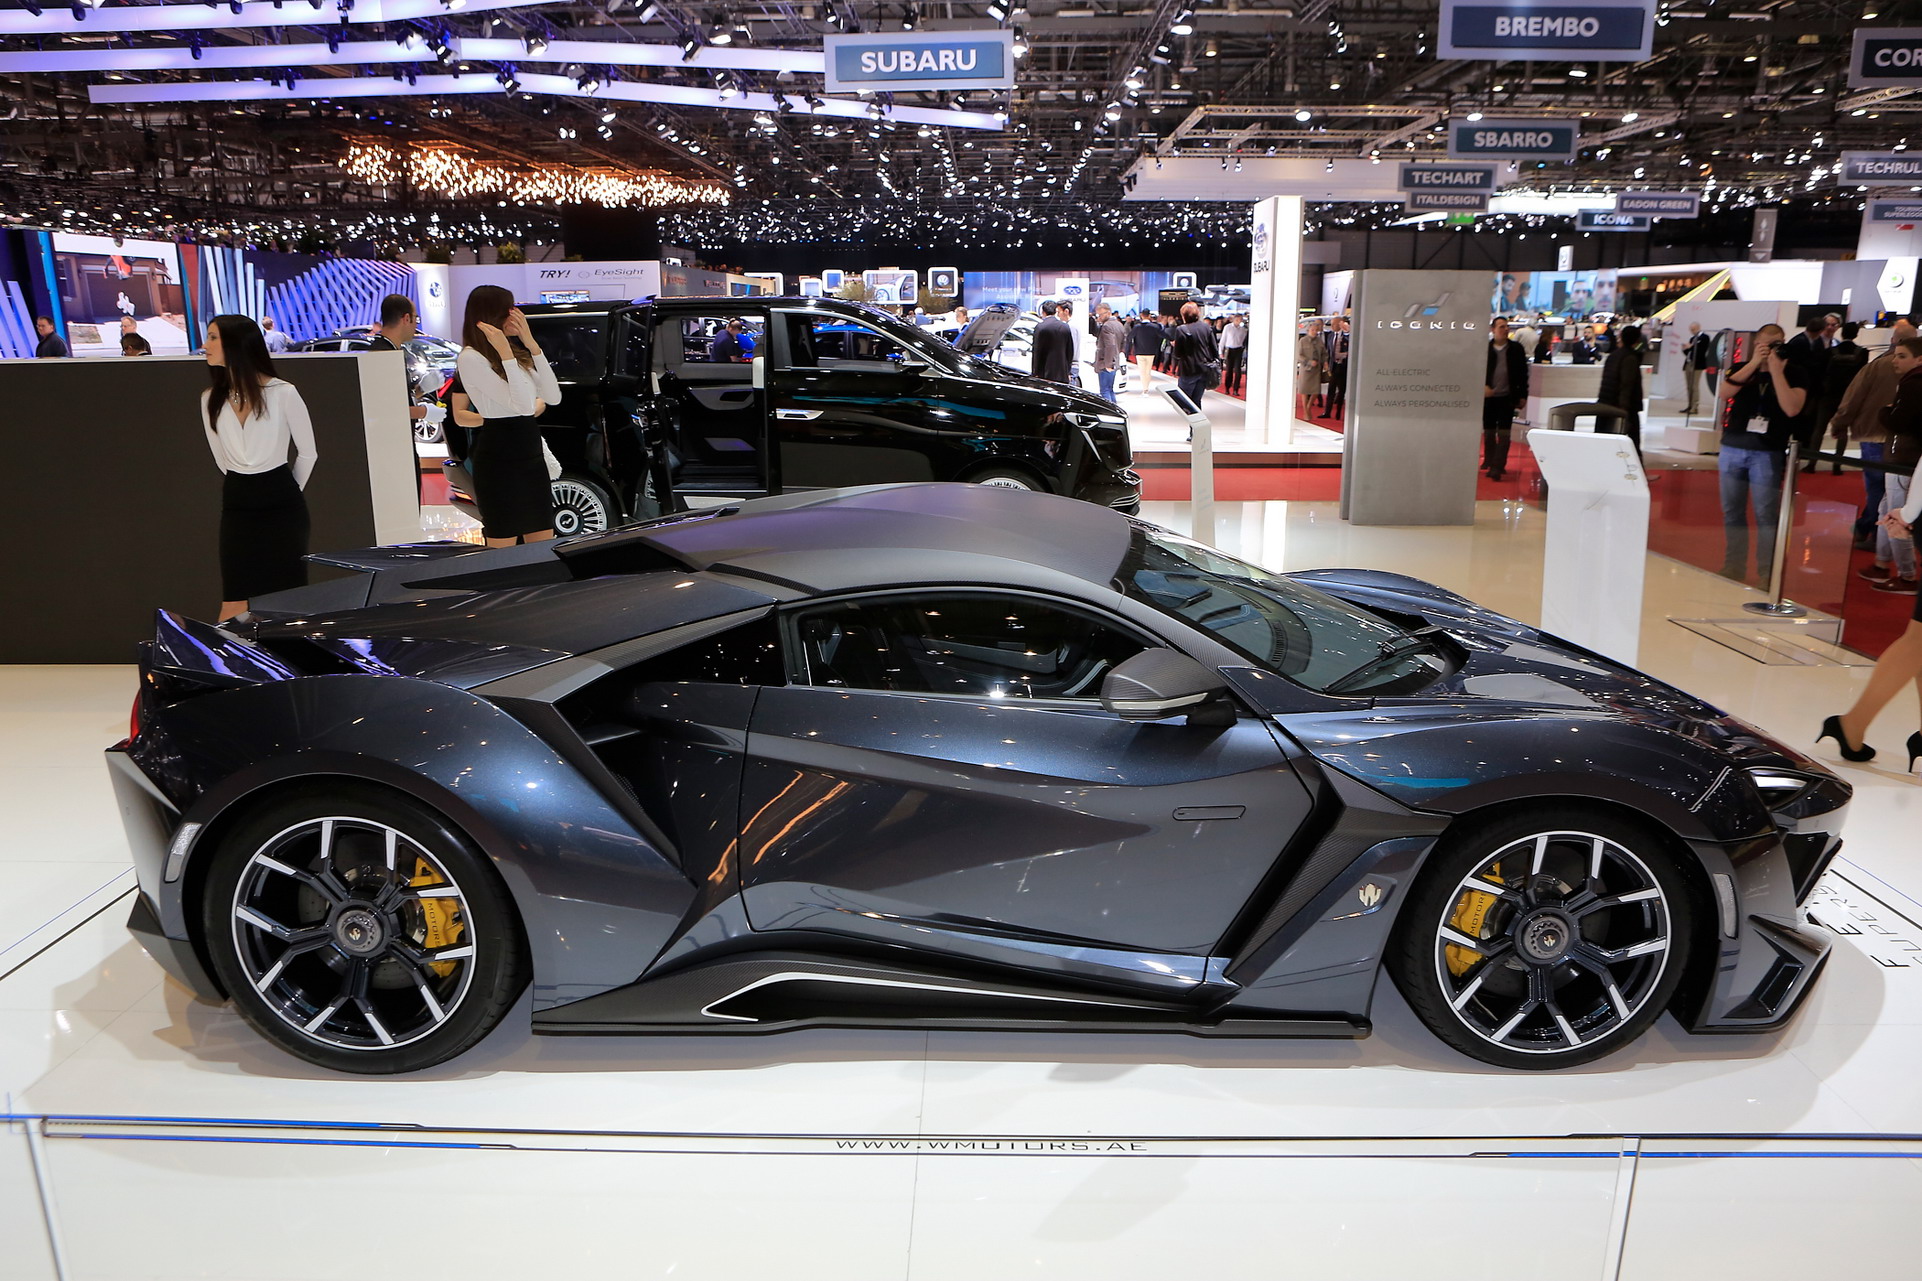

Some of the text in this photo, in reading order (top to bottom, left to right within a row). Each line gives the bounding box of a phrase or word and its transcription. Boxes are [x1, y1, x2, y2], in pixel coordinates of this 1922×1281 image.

[1494, 16, 1600, 37] BREMBO
[861, 49, 977, 73] SUBARU
[1473, 131, 1553, 149] SBARRO
[1855, 162, 1922, 174] TECHRUL
[1411, 171, 1485, 185] TECHART
[1416, 195, 1480, 205] ITALDESIGN
[1622, 200, 1692, 210] EADON GREEN
[1593, 214, 1634, 225] ICONA
[540, 270, 571, 278] TRY!
[1376, 368, 1431, 376] ALL-ELECTRIC
[1375, 384, 1461, 392] ALWAYS CONNECTED
[1374, 400, 1470, 408] ALWAYS PERSONALISED
